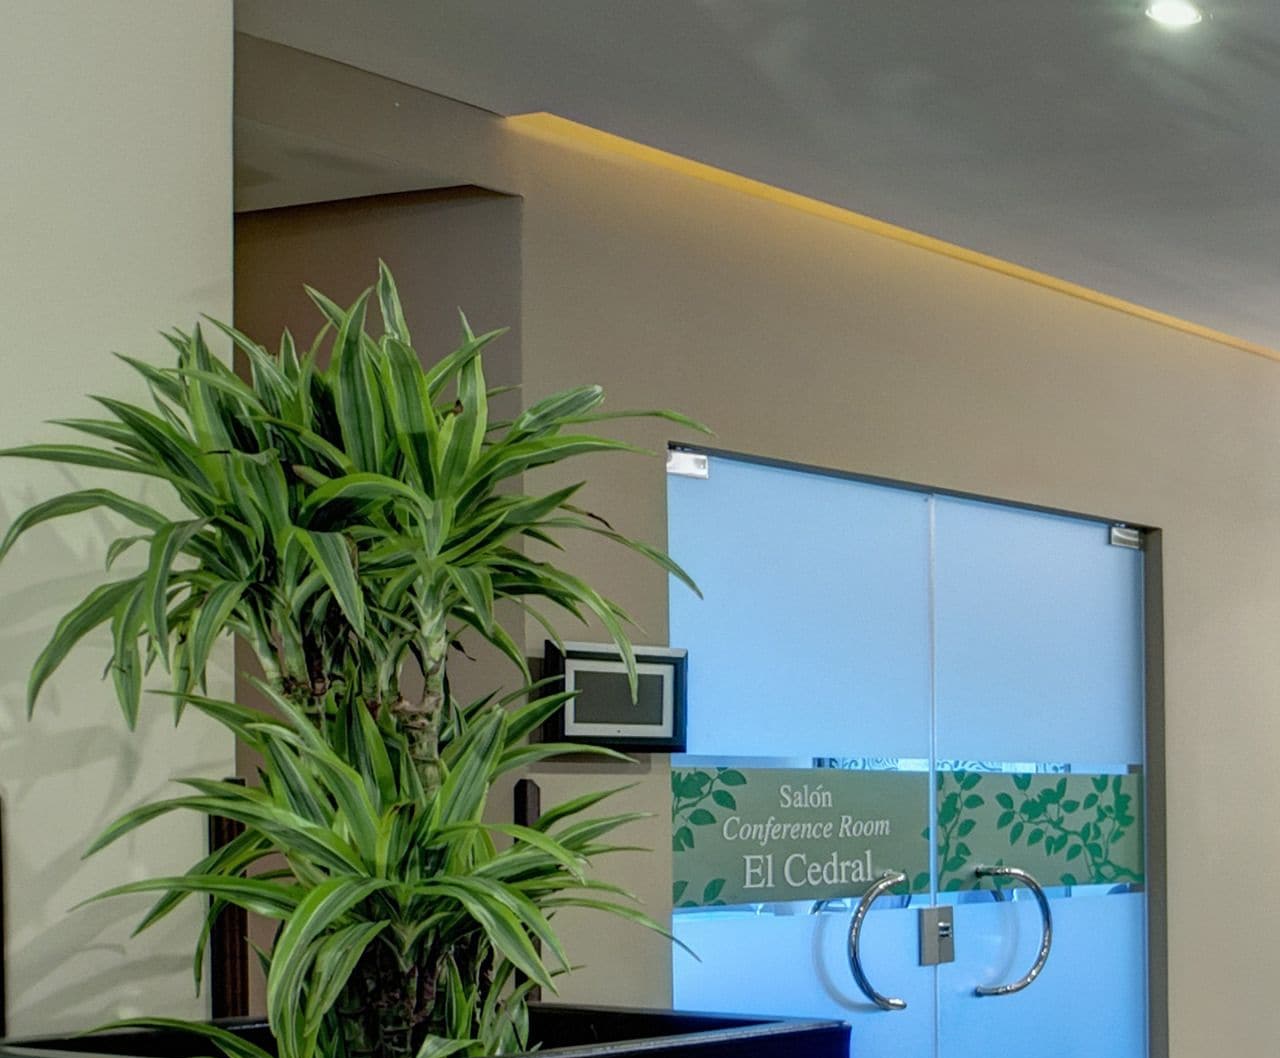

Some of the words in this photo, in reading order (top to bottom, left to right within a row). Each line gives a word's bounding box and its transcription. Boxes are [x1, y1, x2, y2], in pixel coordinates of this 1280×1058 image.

[779, 784, 833, 808] Salón
[722, 815, 833, 847] Conference
[838, 814, 891, 838] Room
[742, 853, 776, 889] El
[783, 849, 874, 888] Cedral
